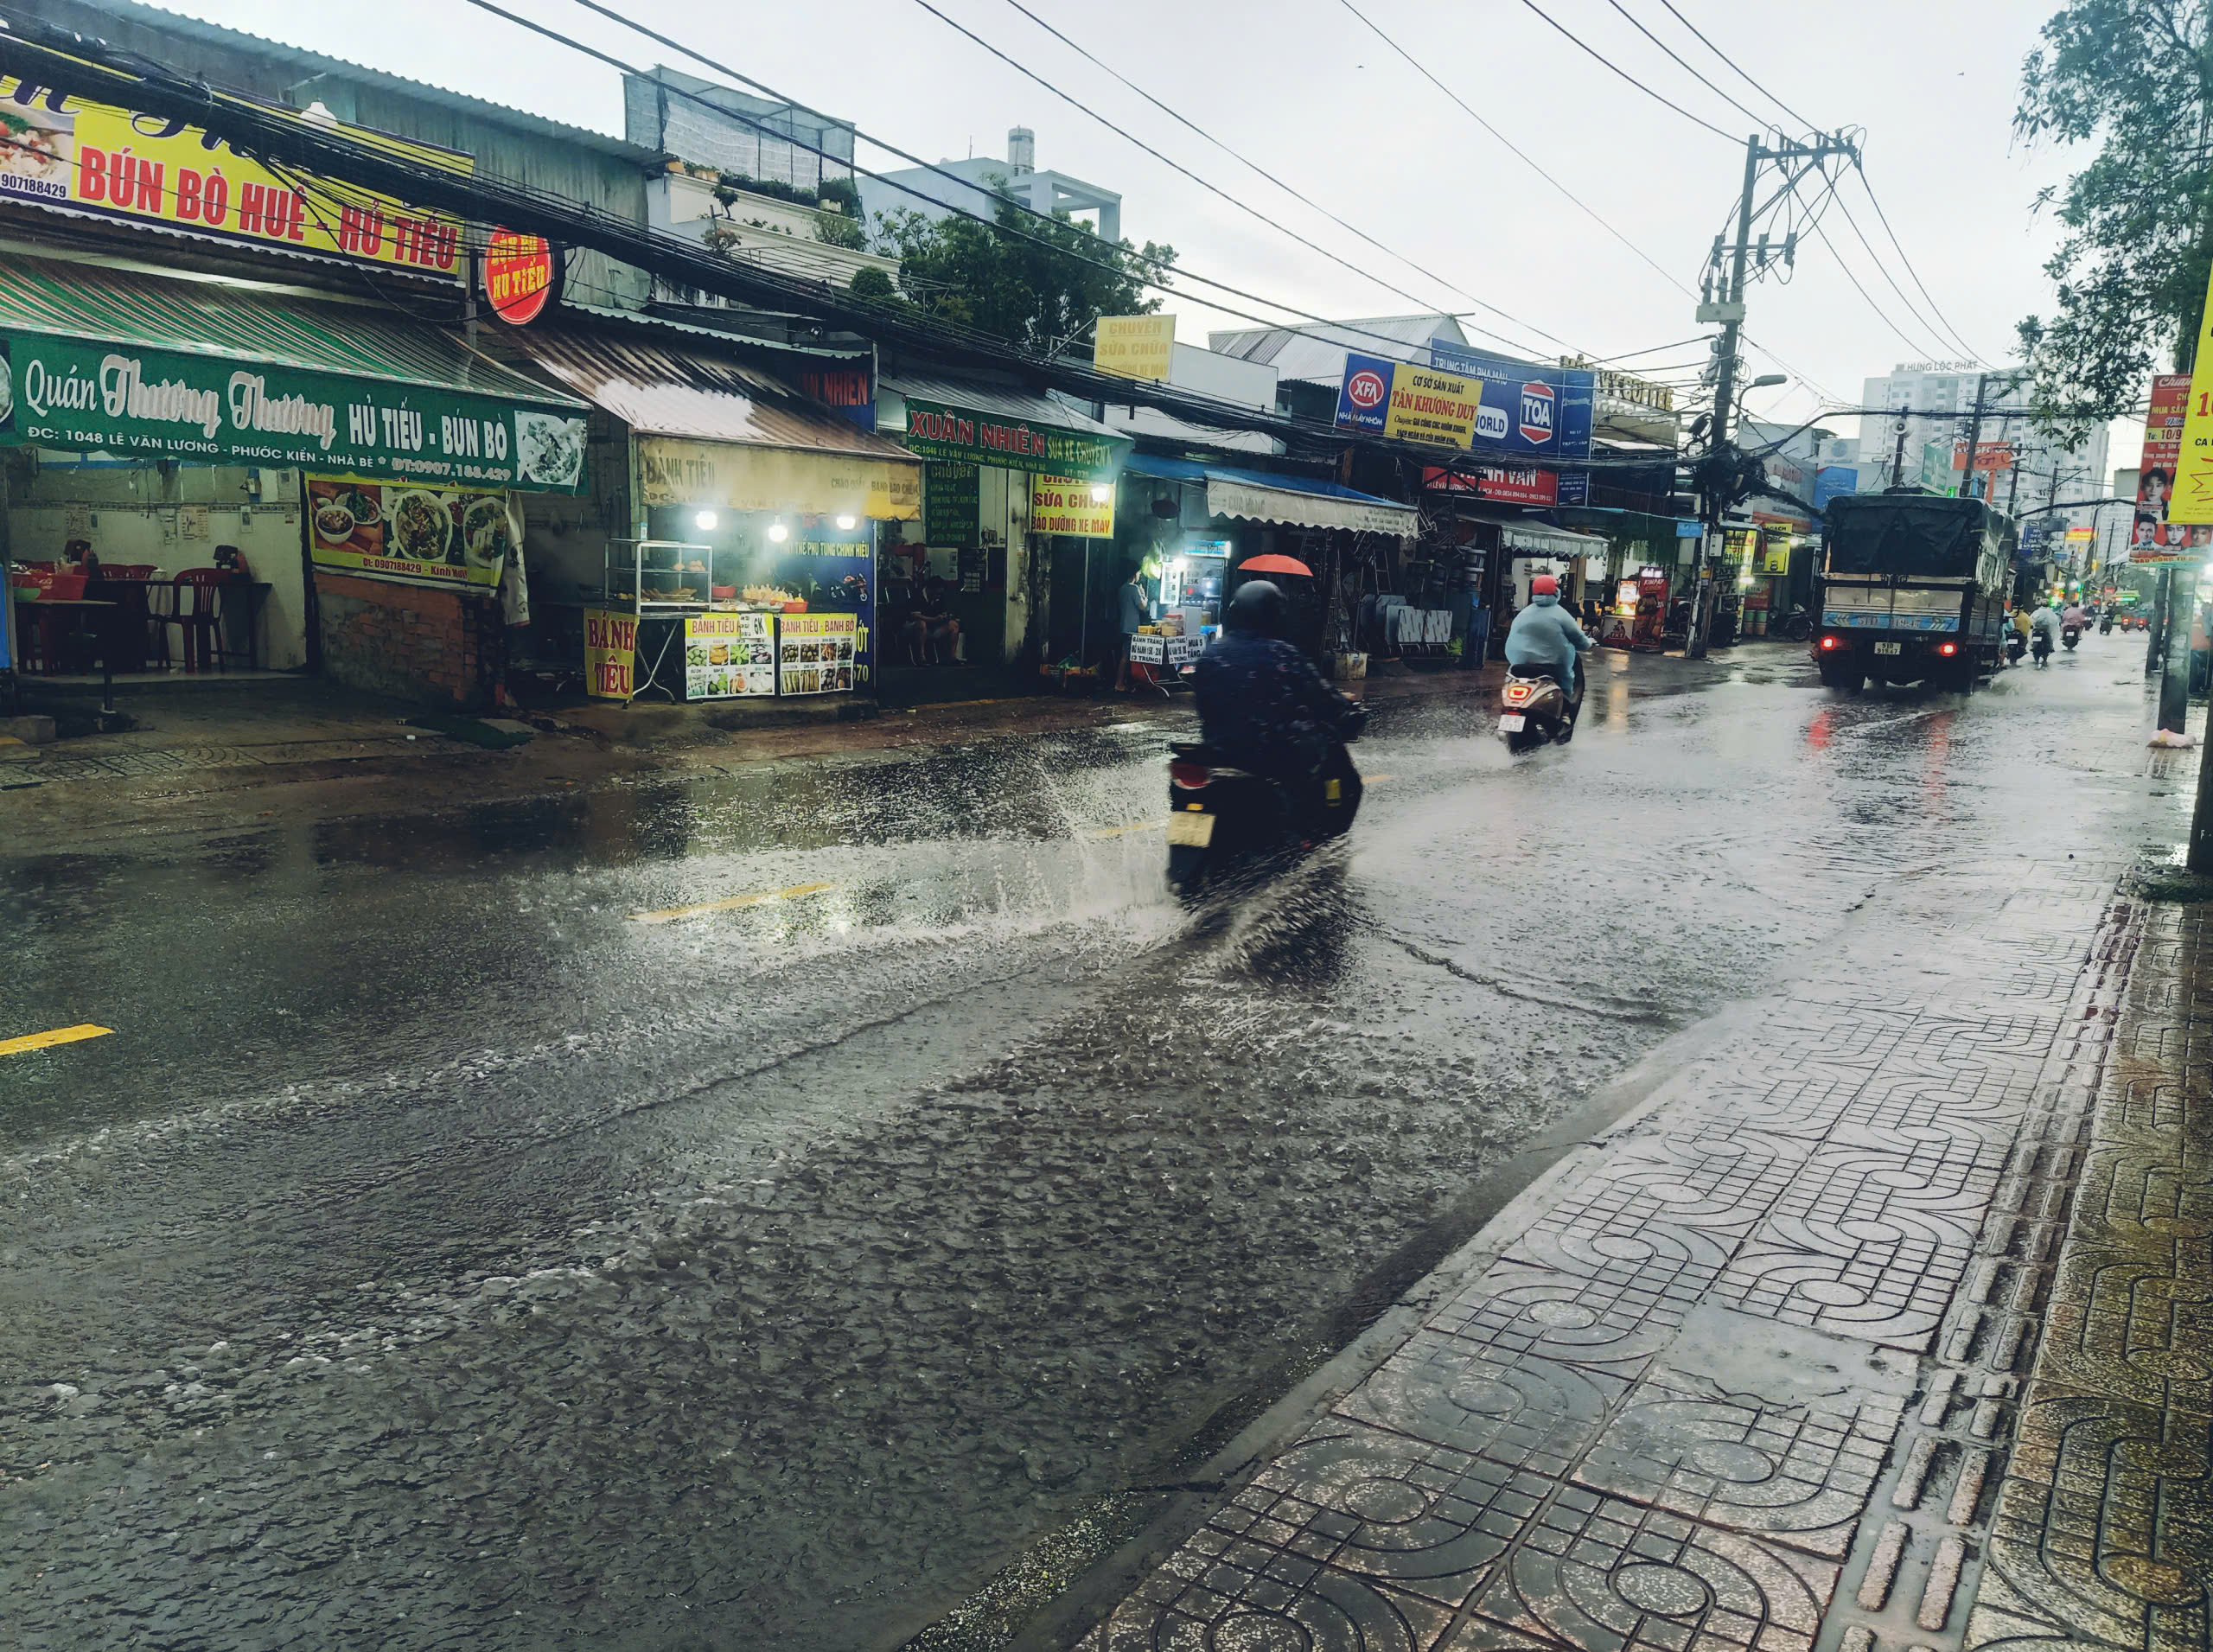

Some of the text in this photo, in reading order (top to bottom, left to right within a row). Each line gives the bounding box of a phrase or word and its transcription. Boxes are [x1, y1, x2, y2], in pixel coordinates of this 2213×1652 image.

[79, 146, 163, 214] BÚN
[175, 167, 227, 226] BÒ
[1434, 356, 1460, 371] TRUNG
[1433, 377, 1447, 391] SẢN
[25, 359, 97, 417] Quán
[99, 354, 221, 439] Thương
[228, 371, 337, 450] Thương
[348, 394, 376, 447] HỦ
[381, 397, 423, 451] TIẾU
[441, 408, 479, 457] BÚN
[484, 413, 507, 461] BÒ
[1392, 387, 1413, 409] TÂN
[1456, 402, 1477, 421] DUY
[1523, 398, 1551, 427] TOA
[28, 426, 60, 440] ĐC:
[66, 430, 104, 443] 1048
[109, 431, 124, 446] LÊ
[130, 433, 163, 449] VĂN
[167, 438, 220, 454] LƯƠNG
[232, 442, 282, 459] PHƯỚC
[286, 446, 316, 462] KIỂN
[328, 453, 355, 467] NHÀ
[360, 456, 373, 469] BÈ
[909, 410, 1044, 457] XUÂN NHIÊN
[2161, 429, 2182, 440] 10/9
[646, 448, 683, 486] BÁNH
[1034, 488, 1063, 507] SỬA
[1032, 512, 1110, 533] BẢO DƯỠNG XE MÁY
[692, 616, 715, 634] BÁNH
[717, 617, 735, 634] TIÊU
[802, 618, 819, 633] TIÊU
[588, 610, 635, 694] BÁNH TIÊU
